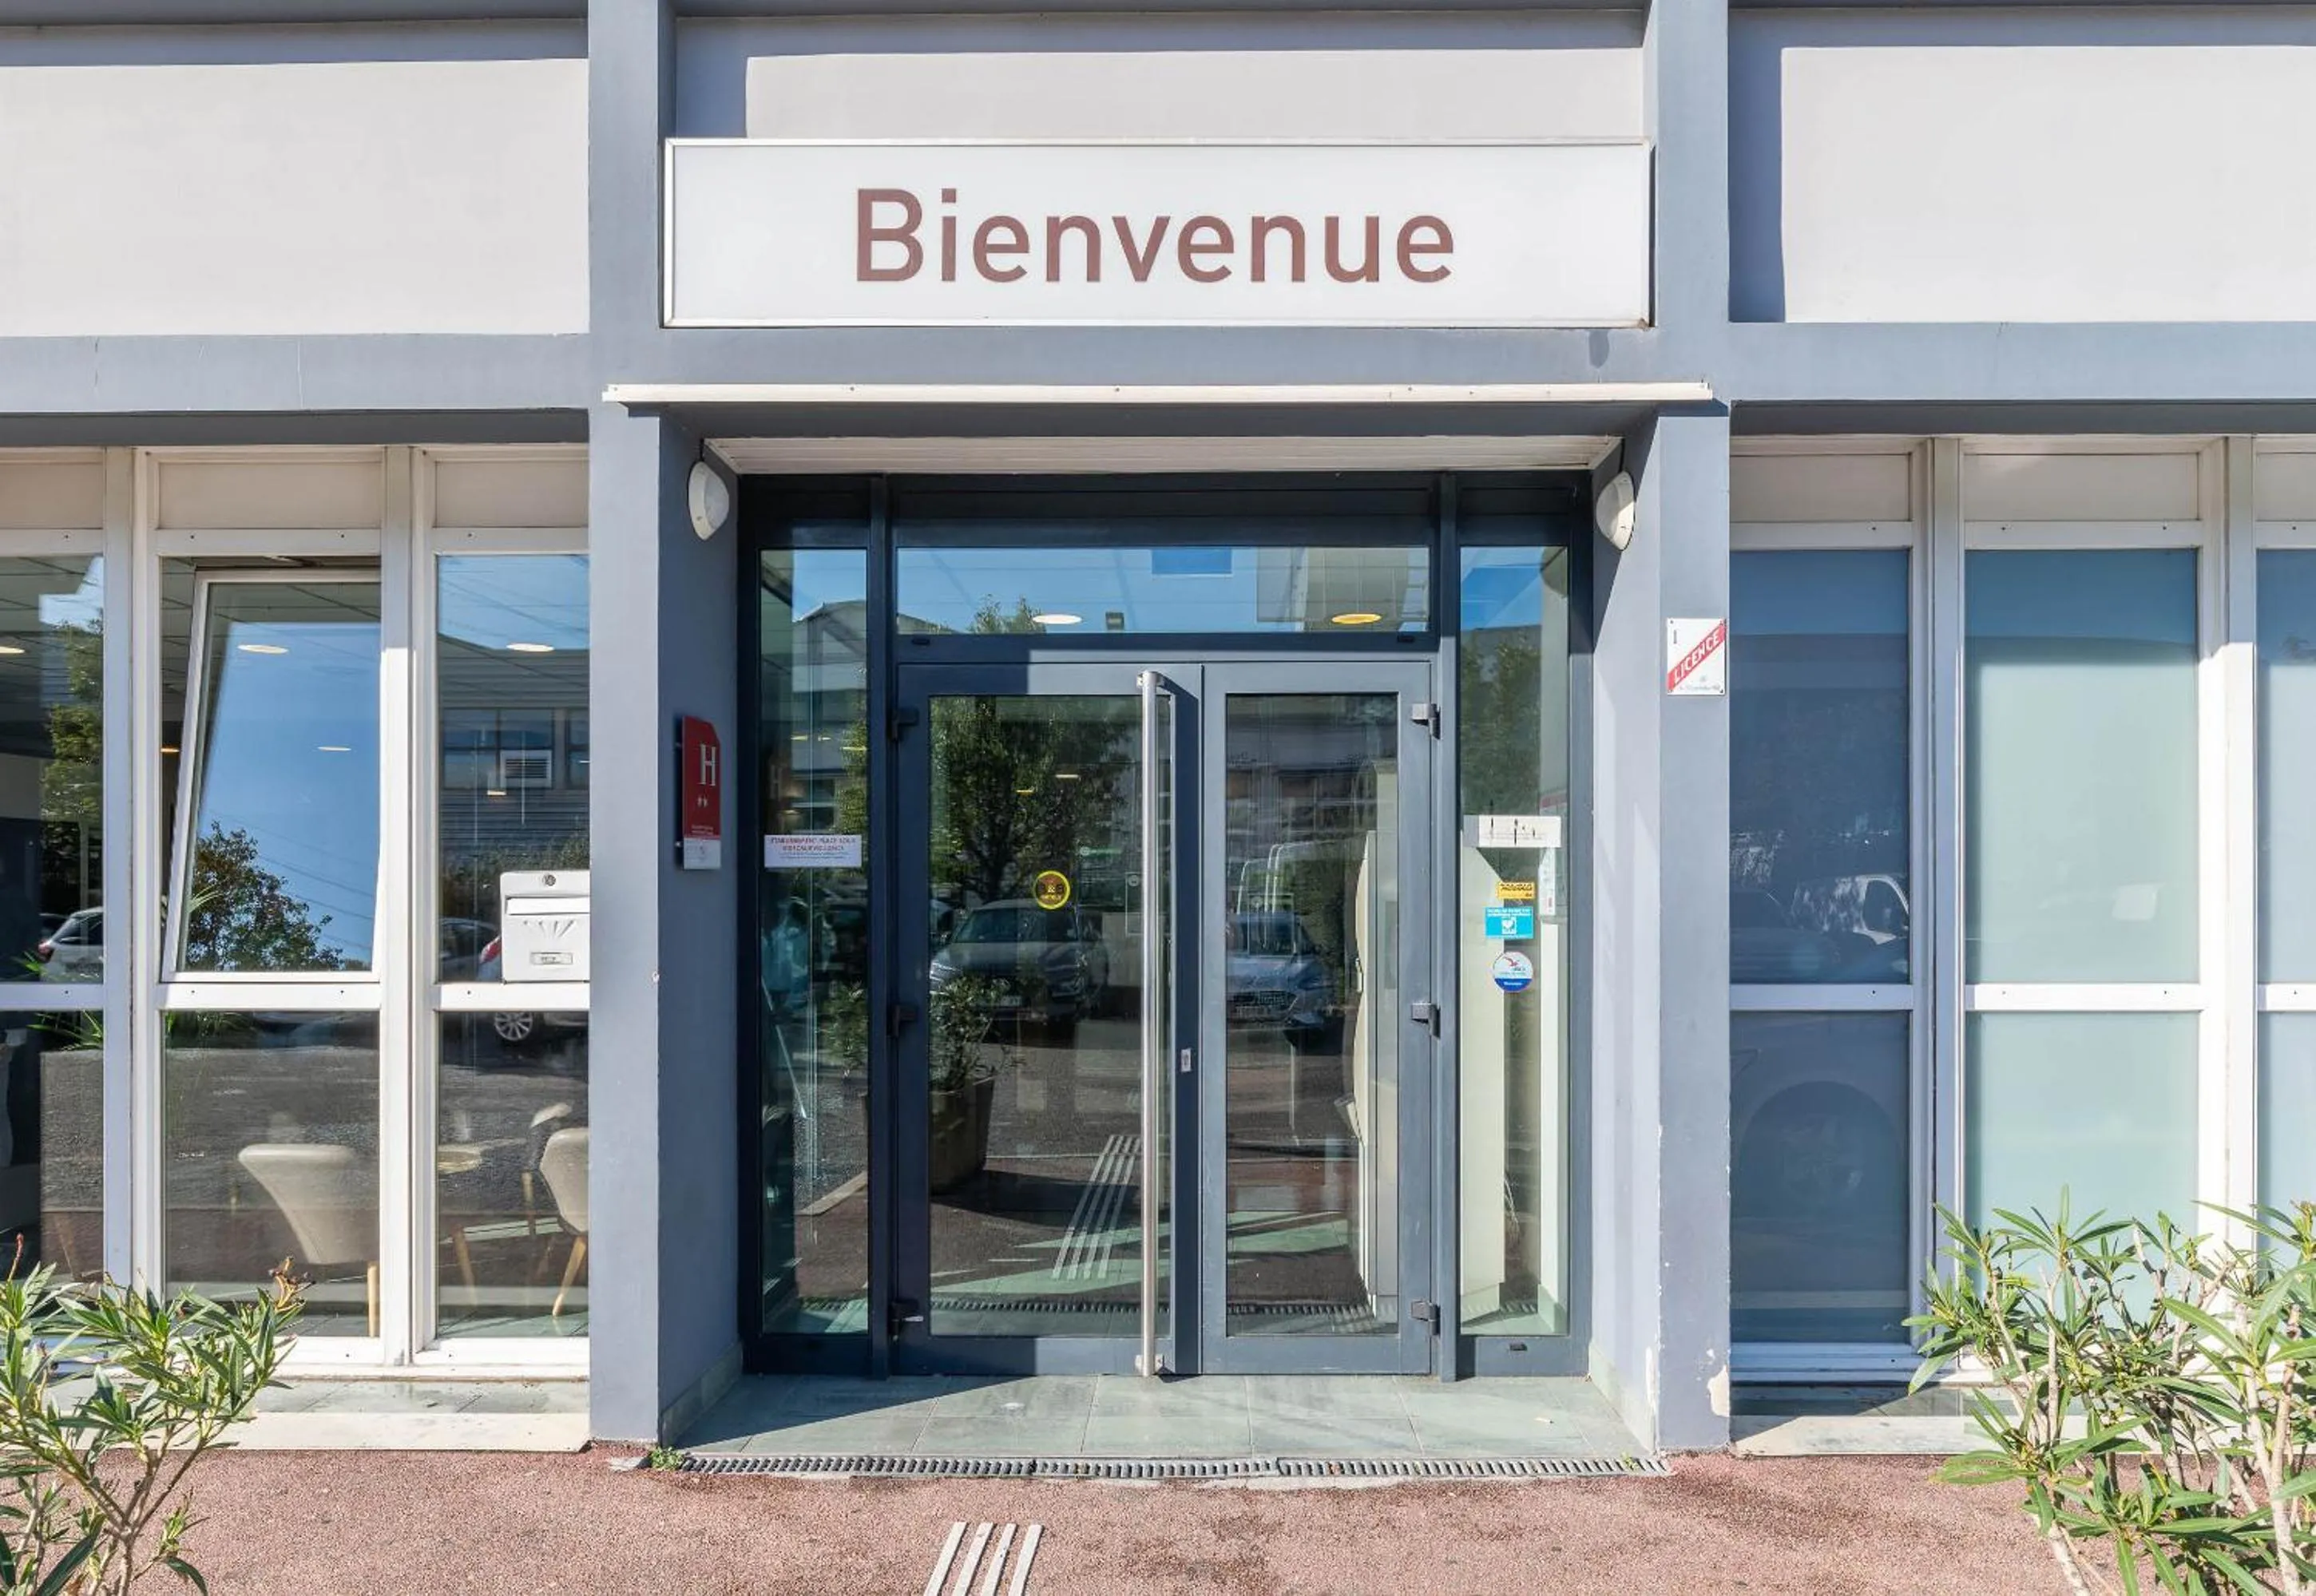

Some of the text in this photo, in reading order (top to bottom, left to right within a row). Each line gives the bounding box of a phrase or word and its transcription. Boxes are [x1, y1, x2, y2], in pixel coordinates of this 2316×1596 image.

[856, 188, 1454, 283] Bienvenue
[1674, 629, 1720, 685] LICENCE
[699, 743, 716, 786] H
